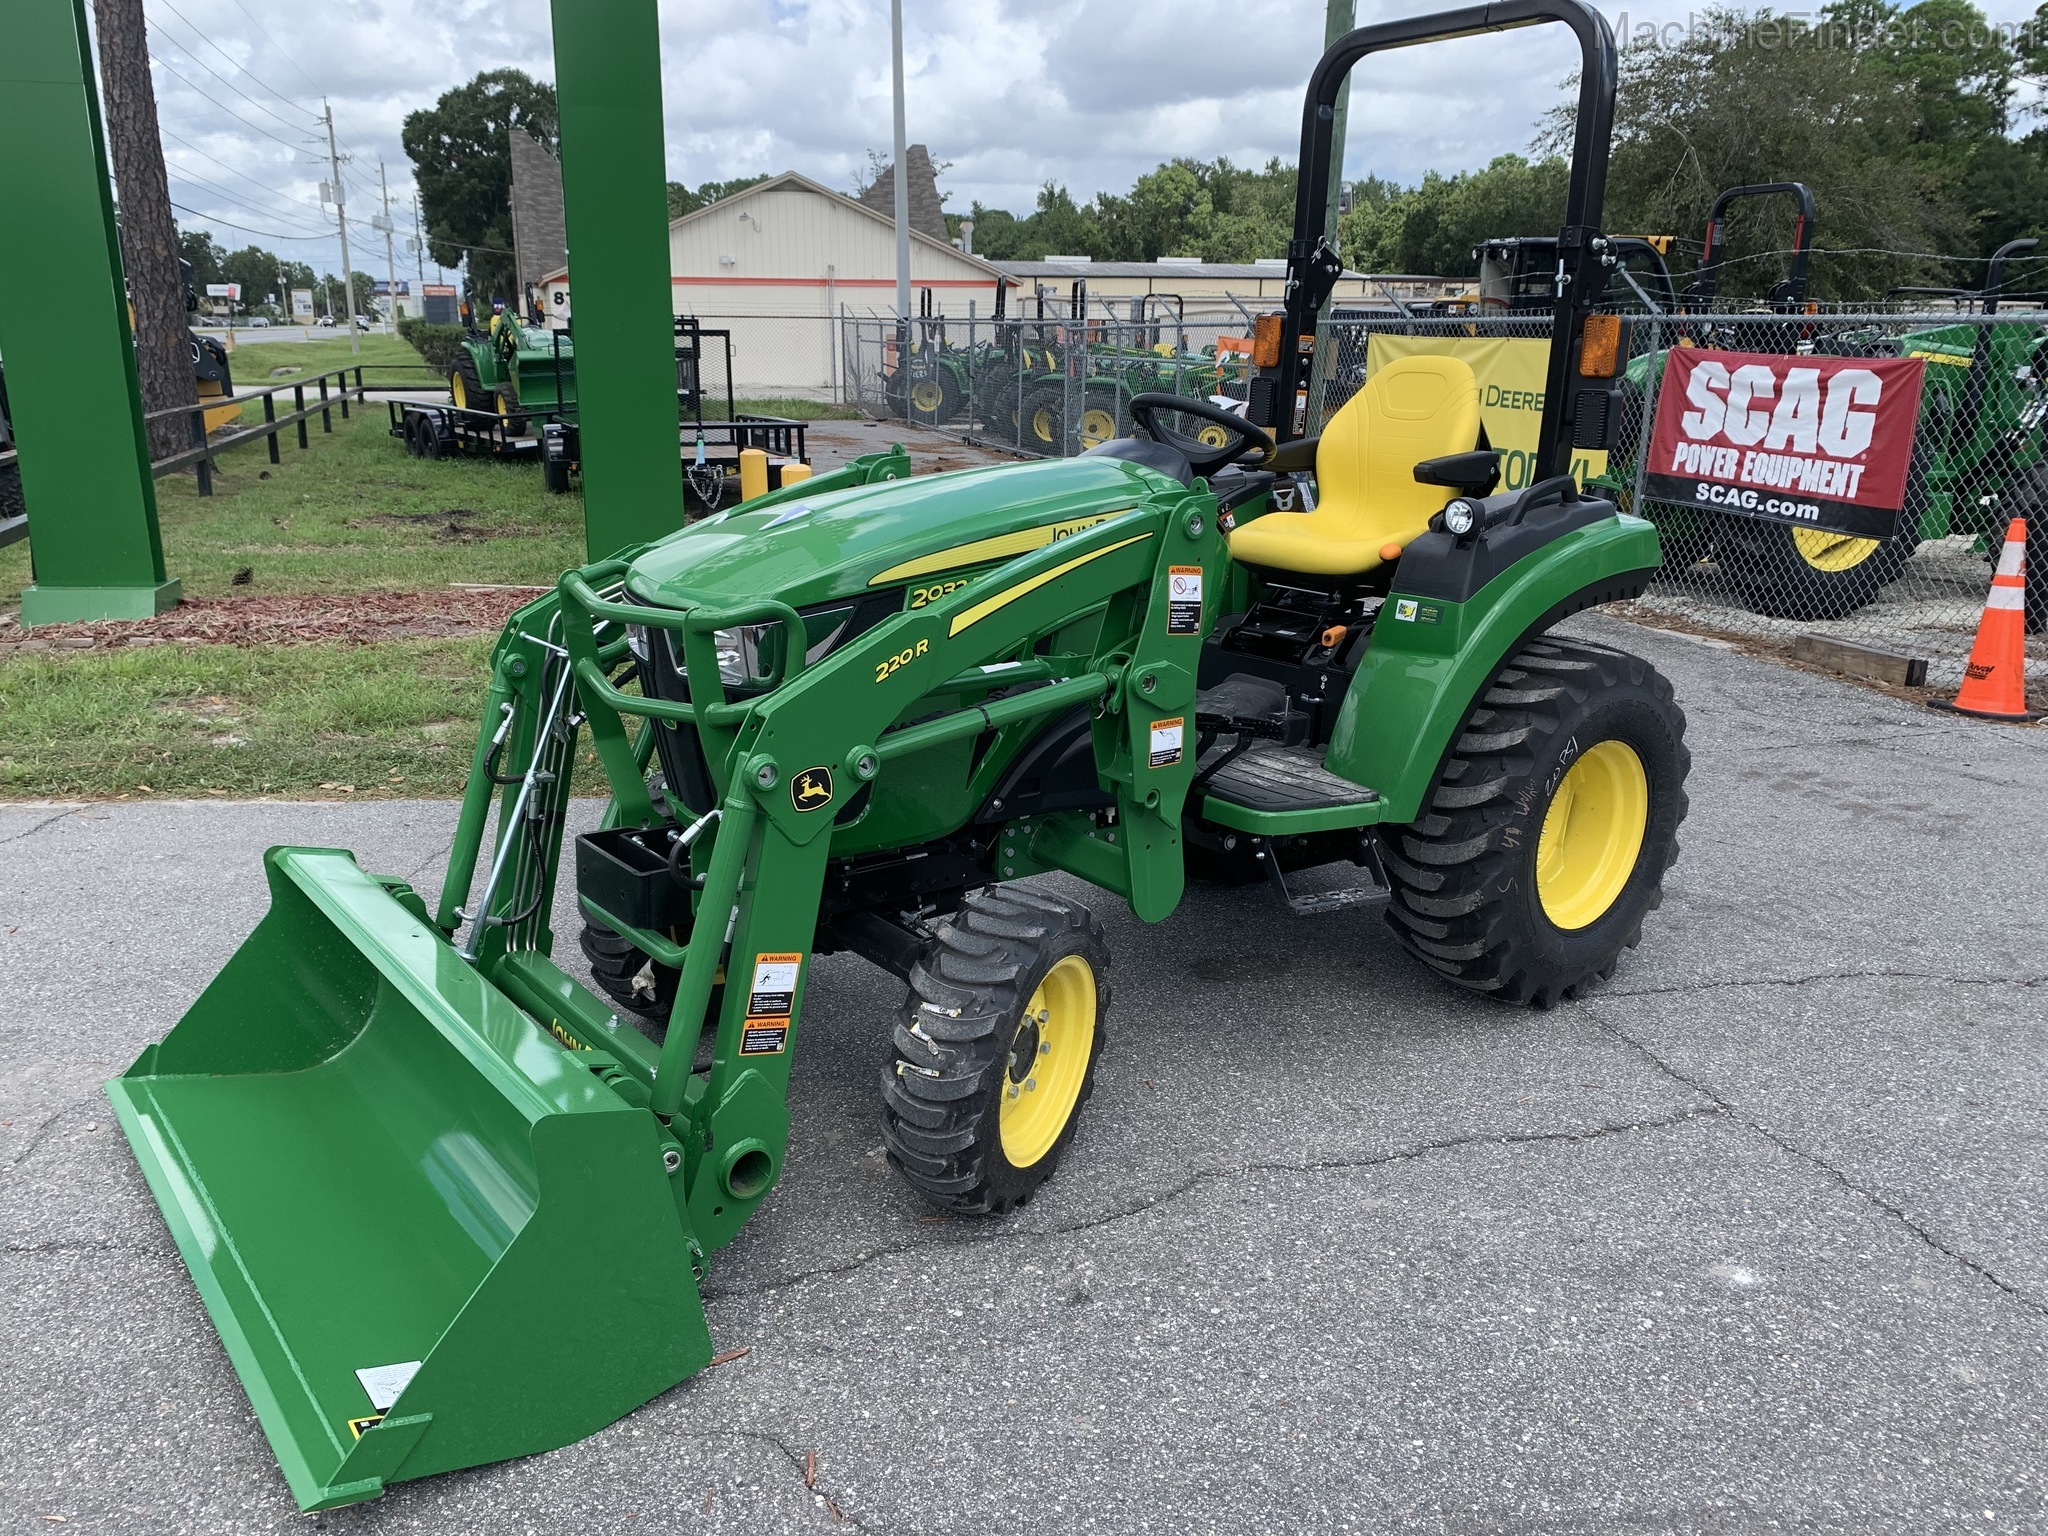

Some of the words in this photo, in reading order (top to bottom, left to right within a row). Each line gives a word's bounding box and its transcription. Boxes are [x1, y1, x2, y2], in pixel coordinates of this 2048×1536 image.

[554, 291, 570, 305] 8
[1485, 384, 1546, 412] DEERE
[1681, 360, 1884, 459] SCAG
[1671, 441, 1740, 480] POWER
[1740, 450, 1865, 499] EQUIPMENT
[1695, 482, 1820, 521] SCAG.com
[1047, 524, 1092, 546] JO
[1175, 567, 1202, 575] WARNING
[875, 648, 914, 684] 220
[916, 638, 929, 658] R
[1157, 718, 1183, 729] WARNING
[757, 1020, 785, 1028] WARNING
